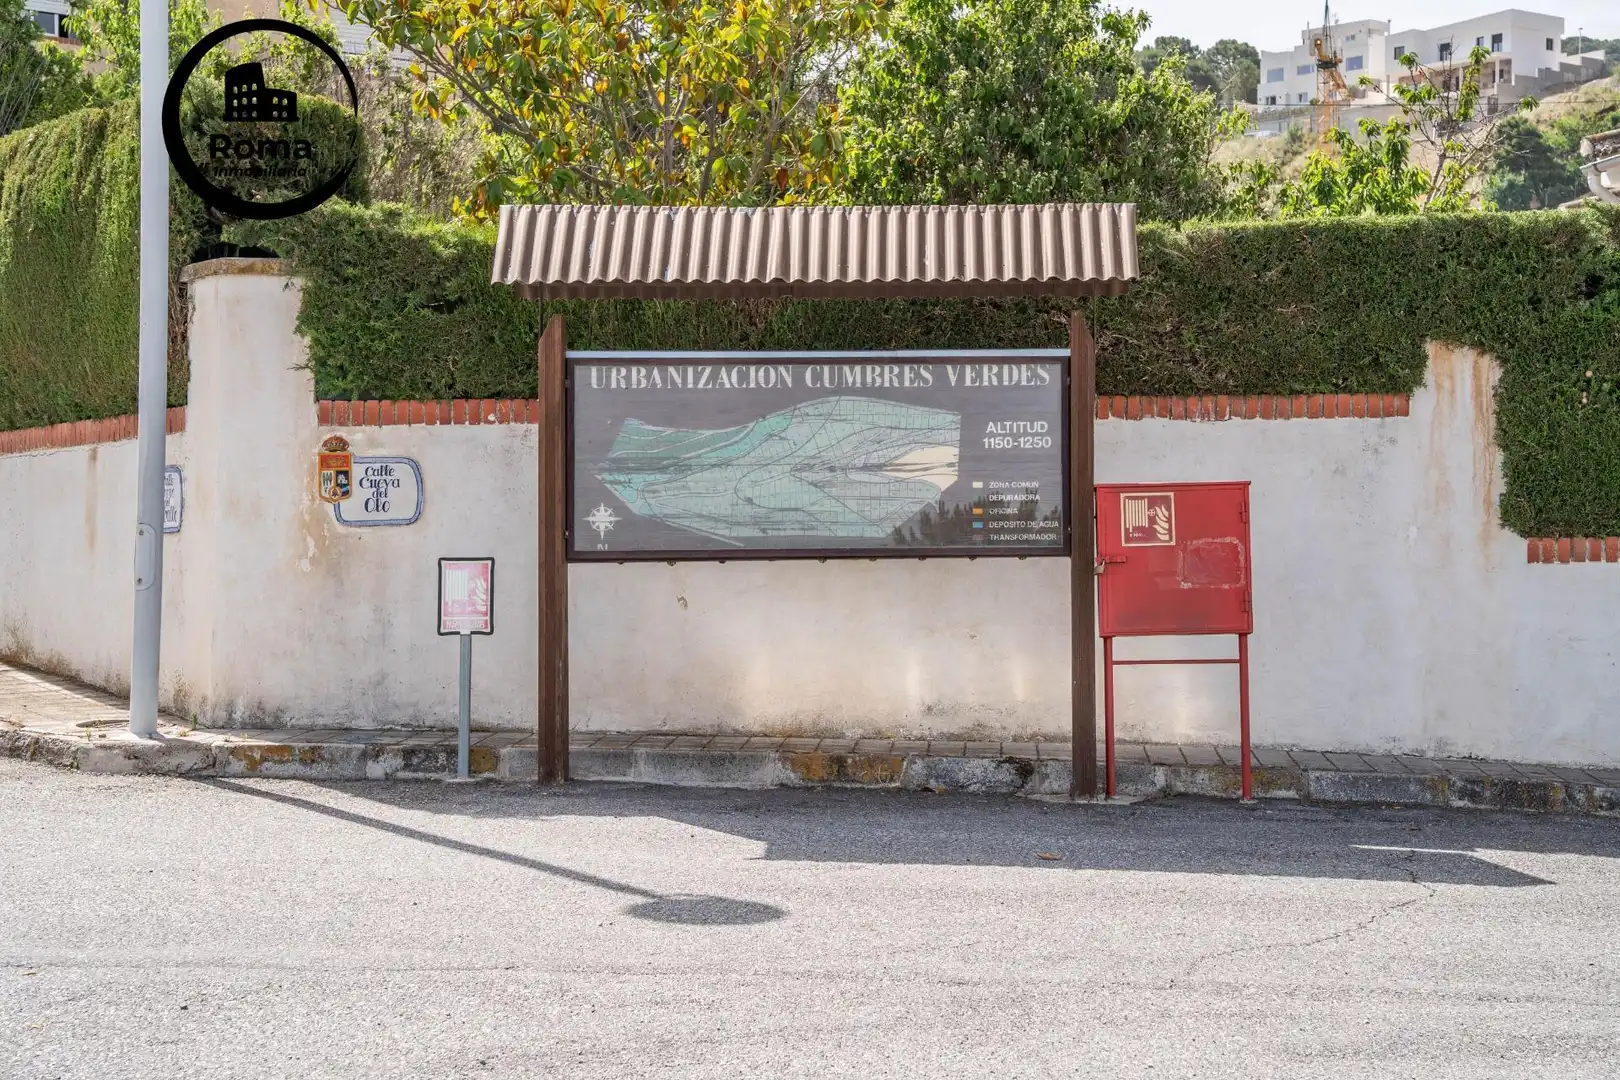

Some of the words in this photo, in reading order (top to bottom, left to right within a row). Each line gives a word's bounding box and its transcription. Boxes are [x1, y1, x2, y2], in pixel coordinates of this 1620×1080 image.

[590, 365, 793, 388] URBANIZACION
[805, 364, 933, 388] CUMBRES
[945, 363, 1050, 387] VERDES
[986, 421, 1048, 434] ALTITUD
[983, 436, 1052, 449] 1150-1250
[365, 464, 395, 477] Calle
[989, 481, 1010, 489] ZONA
[372, 488, 388, 498] del
[989, 494, 1041, 502] DEPURADORA
[989, 507, 1019, 515] OFICINA
[1027, 520, 1039, 528] DE
[1039, 520, 1059, 528] AGUA
[990, 533, 1057, 541] TRANSFORMADOR
